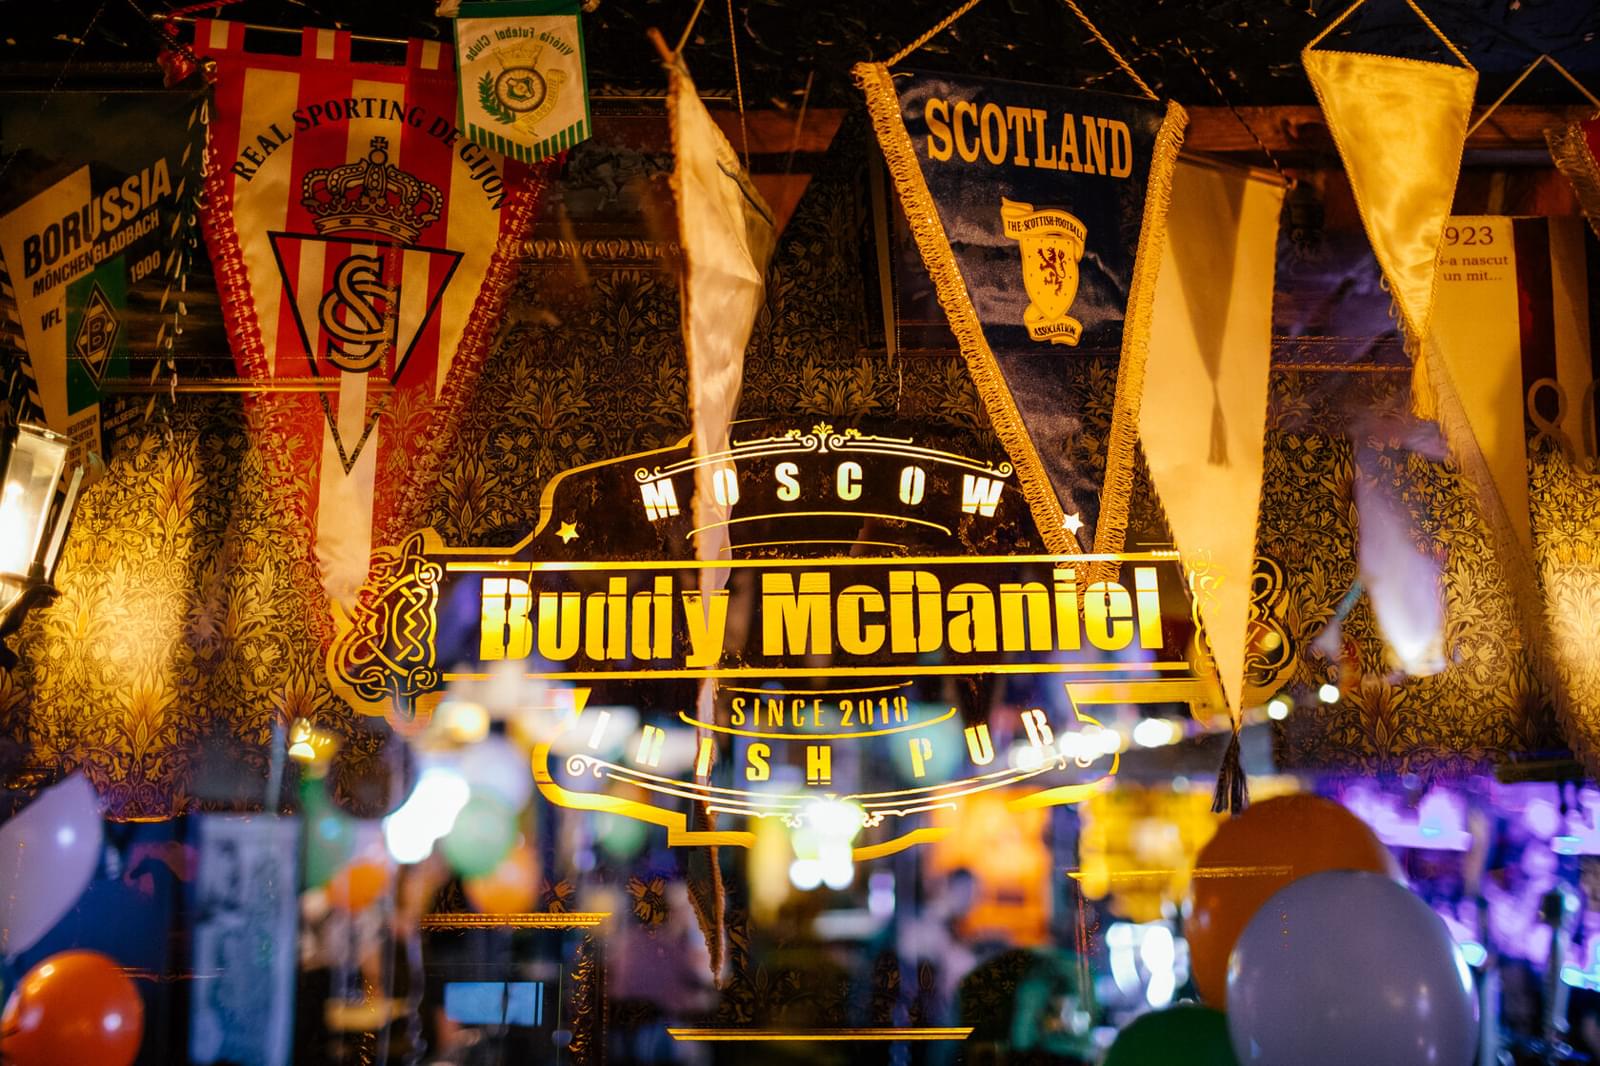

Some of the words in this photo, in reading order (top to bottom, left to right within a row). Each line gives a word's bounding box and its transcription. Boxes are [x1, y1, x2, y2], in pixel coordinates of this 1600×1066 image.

[230, 123, 293, 182] REAL
[292, 97, 427, 132] SPORTING
[428, 117, 465, 148] DE
[924, 97, 1133, 179] SCOTLAND
[23, 157, 172, 280] BORUSSIA
[1007, 220, 1022, 233] THE
[1445, 226, 1494, 246] 923
[32, 209, 160, 298] MÖNCHENGLADBACH
[130, 250, 161, 283] 1900
[1462, 256, 1509, 266] nascut
[1443, 273, 1462, 281] un
[41, 307, 62, 332] VFL
[1033, 322, 1077, 337] ASSOCIATION
[639, 460, 1005, 522] MOSCOW
[480, 576, 730, 668] Buddy
[761, 566, 1163, 658] McDaniel
[730, 696, 826, 729] SINCE
[585, 710, 833, 786] IRISH
[909, 707, 1055, 780] PUB
